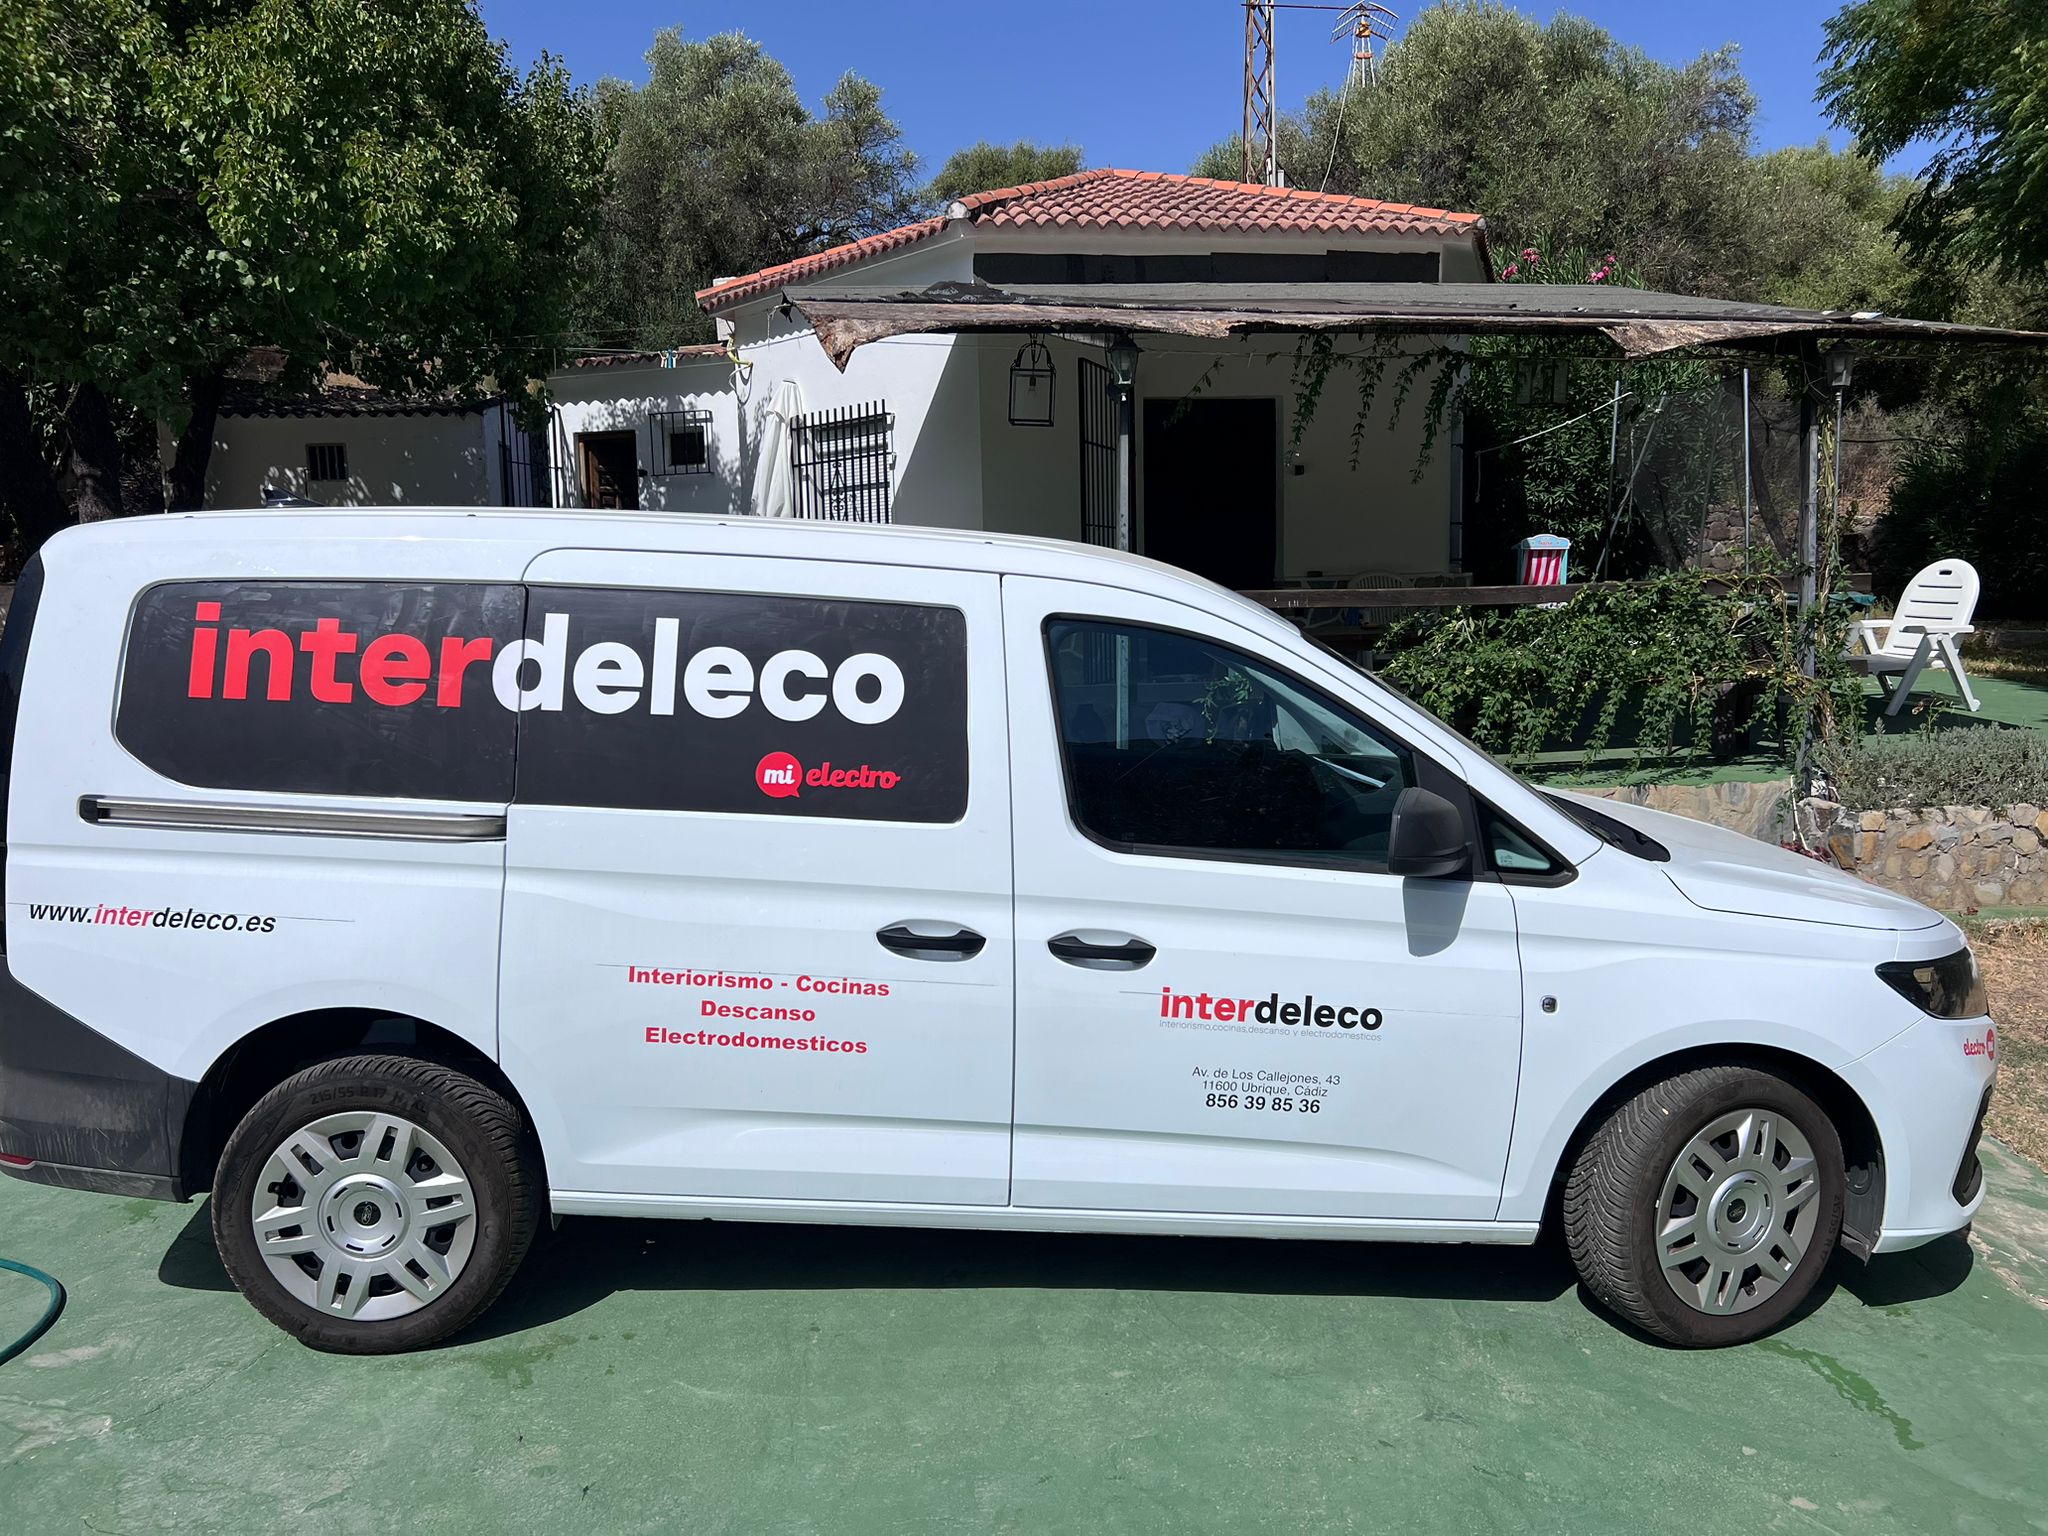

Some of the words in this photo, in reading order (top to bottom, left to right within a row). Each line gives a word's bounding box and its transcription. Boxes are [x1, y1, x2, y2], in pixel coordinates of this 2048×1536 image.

[188, 601, 904, 724] interdeleco
[764, 764, 795, 784] mi
[806, 762, 902, 789] electro
[29, 905, 275, 933] www.interdeleco.es
[629, 966, 773, 990] Interiorismo
[796, 976, 890, 996] Cocinas
[701, 1000, 816, 1022] Descanso
[1161, 986, 1382, 1031] interdeleco
[645, 1027, 867, 1054] Electrodomesticos
[1192, 1066, 1209, 1077] Av.
[1213, 1068, 1228, 1079] de
[1232, 1069, 1253, 1080] Los
[1257, 1070, 1322, 1085] Callejones,
[1325, 1075, 1341, 1086] 43
[1203, 1080, 1238, 1092] 11600
[1241, 1082, 1290, 1096] Ubrique,
[1294, 1085, 1328, 1097] Cádiz
[1205, 1093, 1239, 1109] 856
[1244, 1095, 1266, 1110] 39
[1271, 1097, 1293, 1112] 85
[1298, 1099, 1321, 1114] 36
